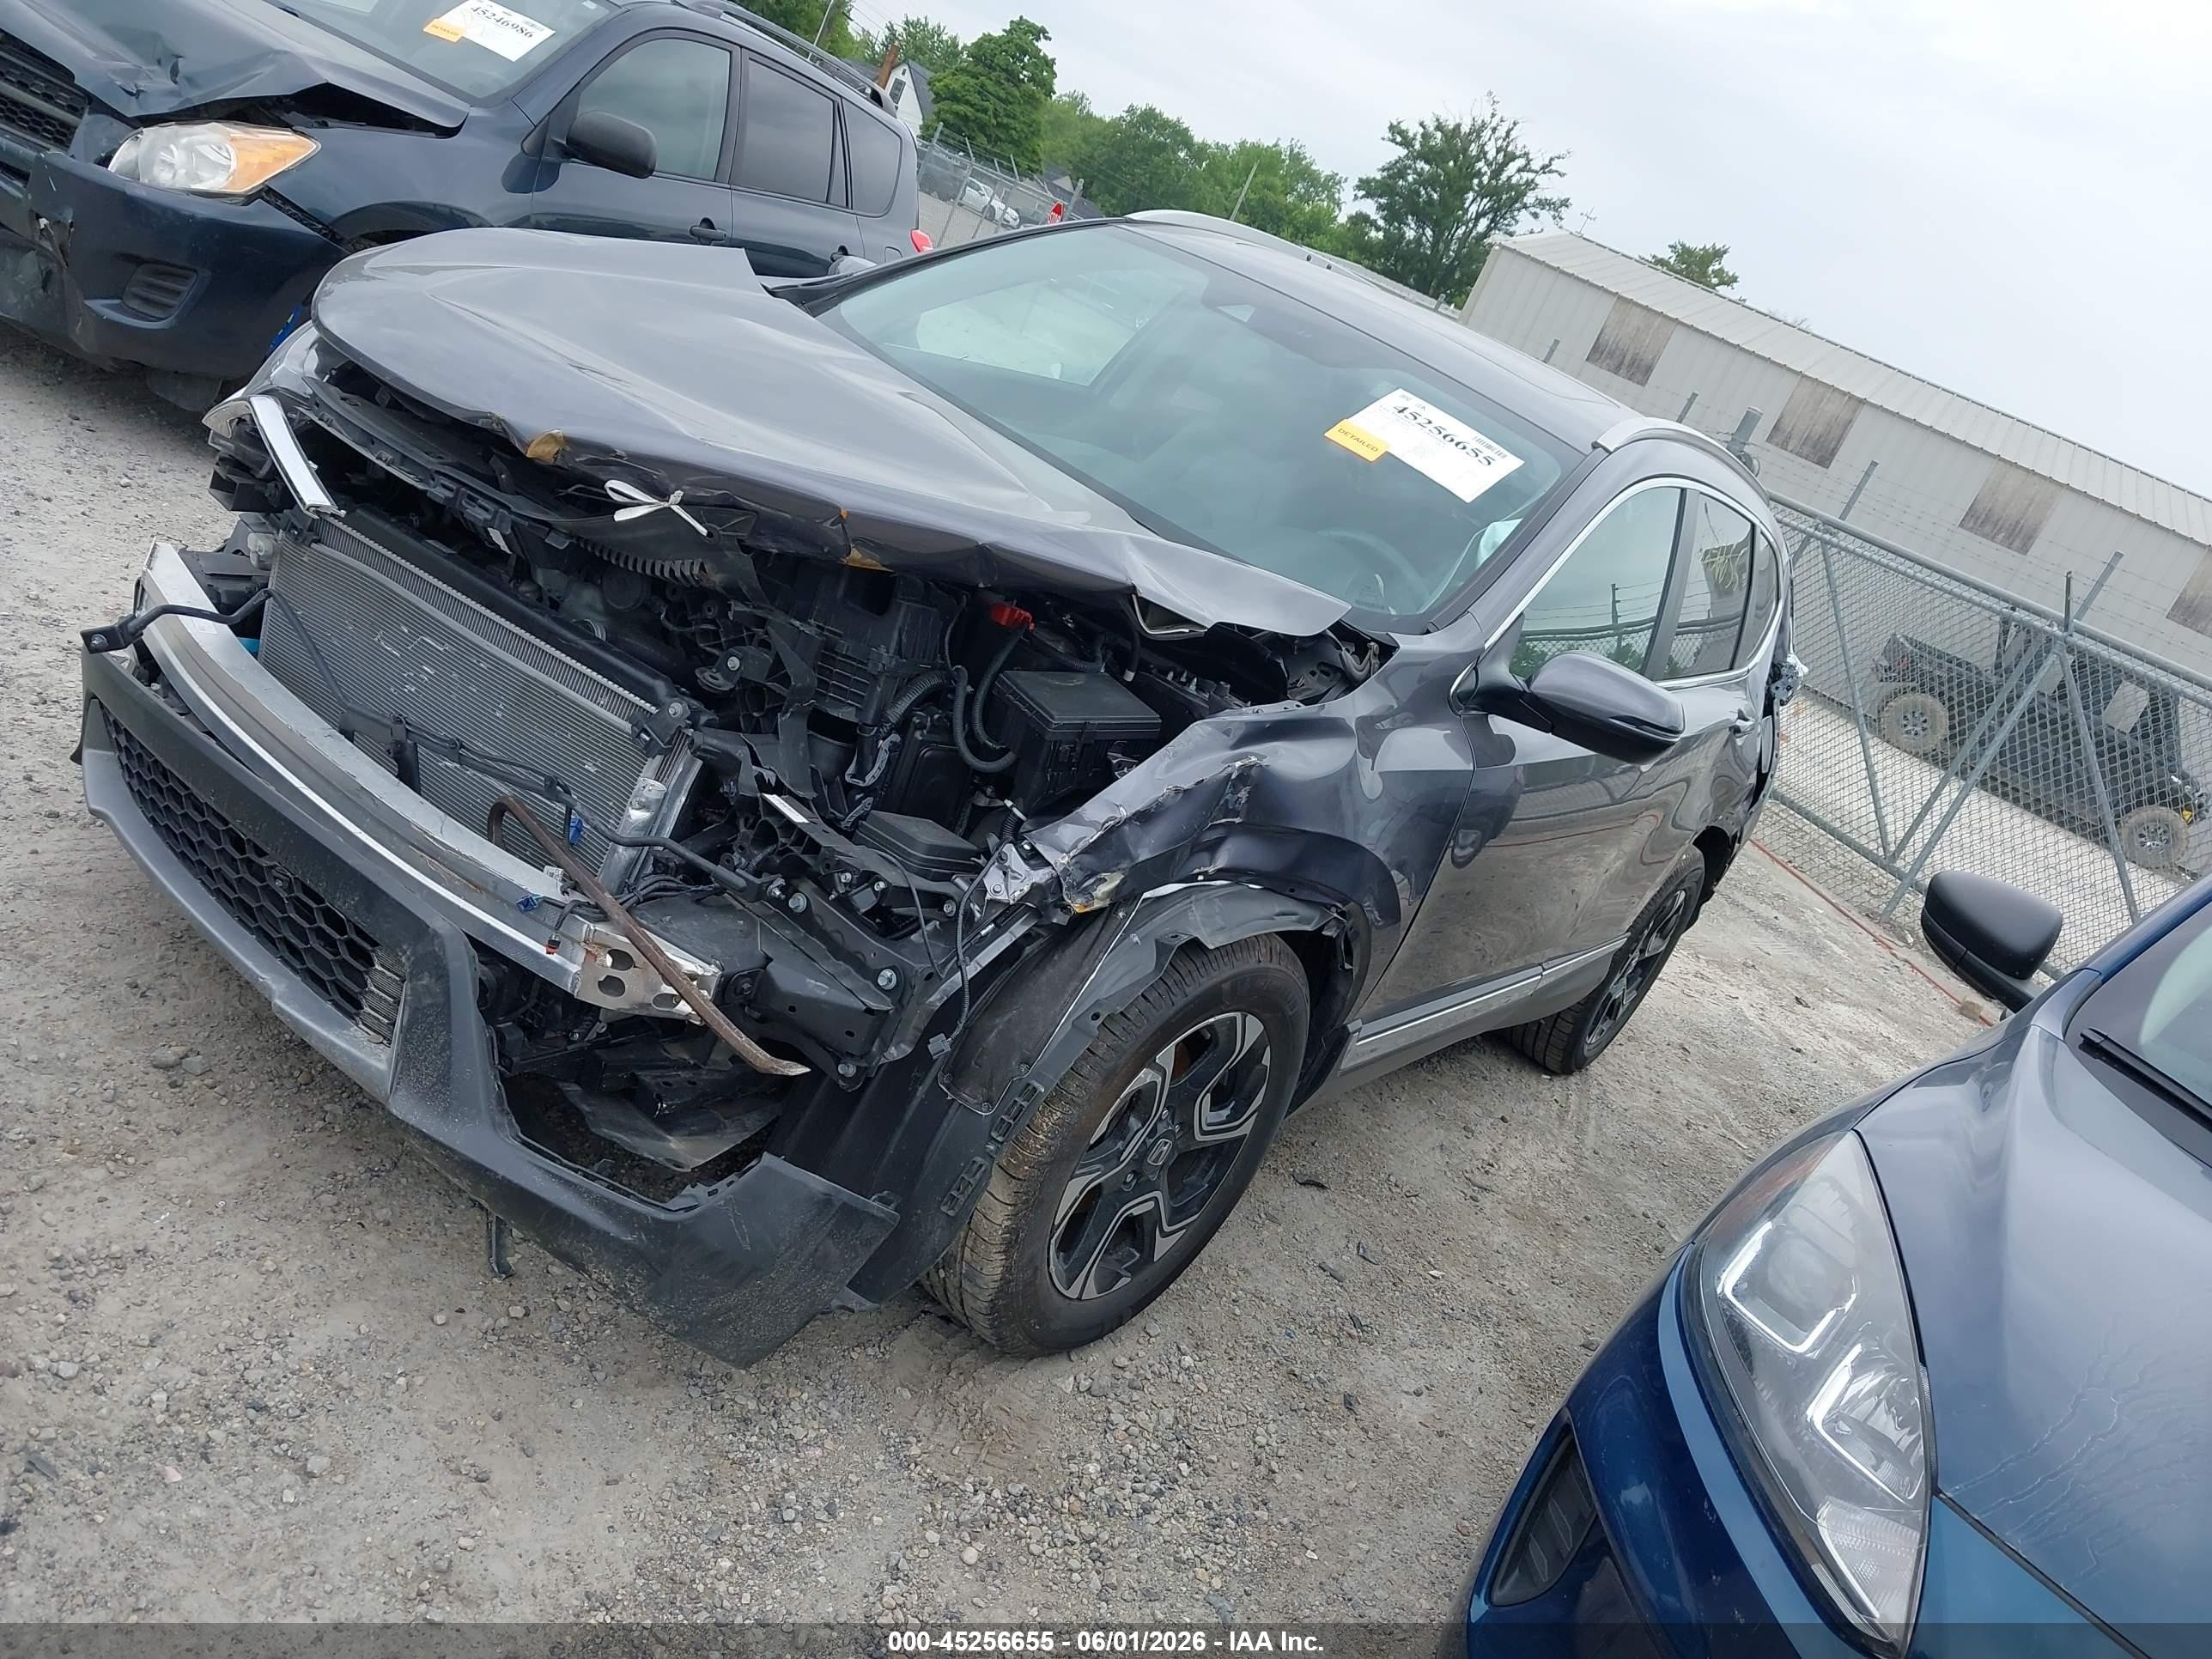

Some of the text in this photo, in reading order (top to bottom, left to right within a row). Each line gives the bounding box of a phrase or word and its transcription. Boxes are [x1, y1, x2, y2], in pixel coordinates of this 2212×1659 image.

[471, 6, 536, 38] 45246986
[1337, 428, 1379, 453] DETAILED
[1393, 404, 1496, 466] 45256655
